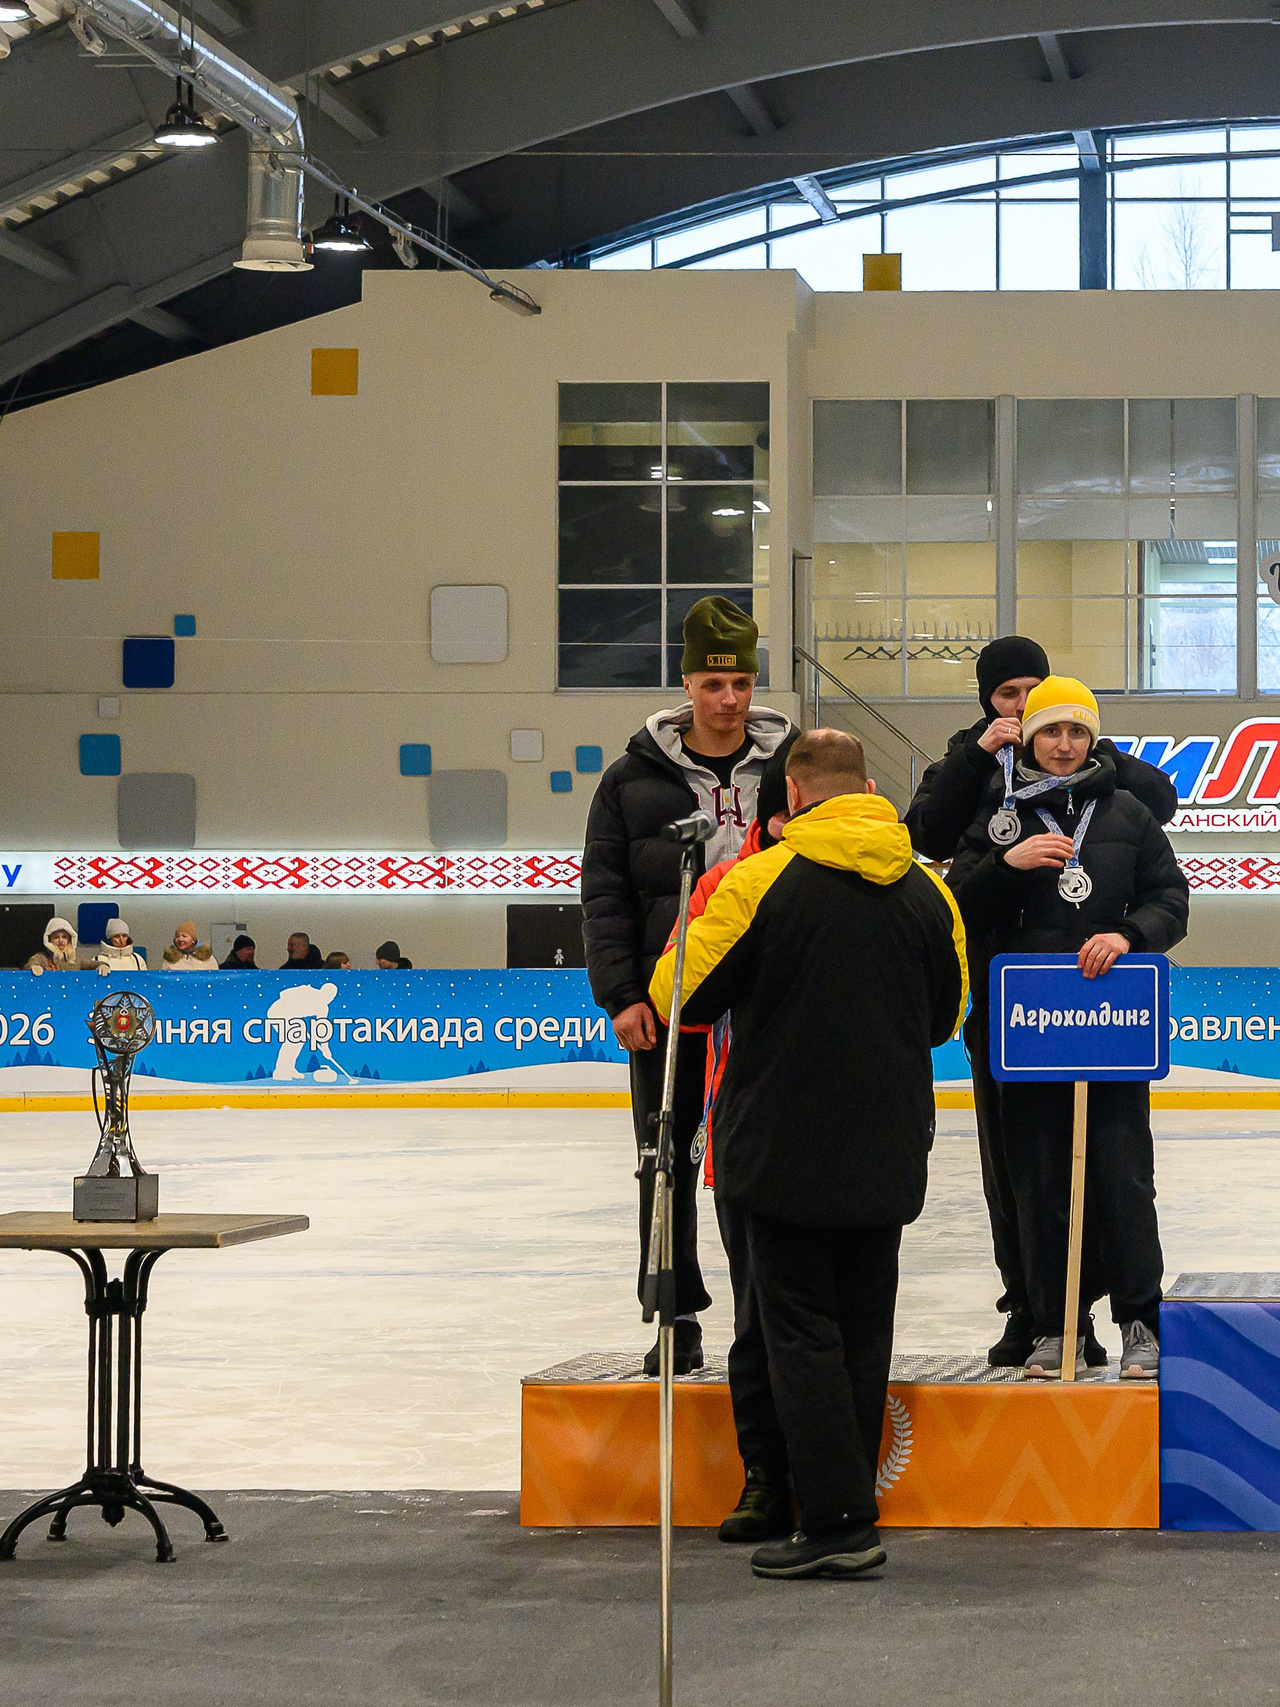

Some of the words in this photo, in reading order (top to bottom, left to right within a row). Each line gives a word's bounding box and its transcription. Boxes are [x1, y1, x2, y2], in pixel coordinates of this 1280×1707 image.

[242, 1017, 484, 1051] спартакиада
[494, 1016, 607, 1050] среди
[1009, 1002, 1150, 1034] Агрохолдинг
